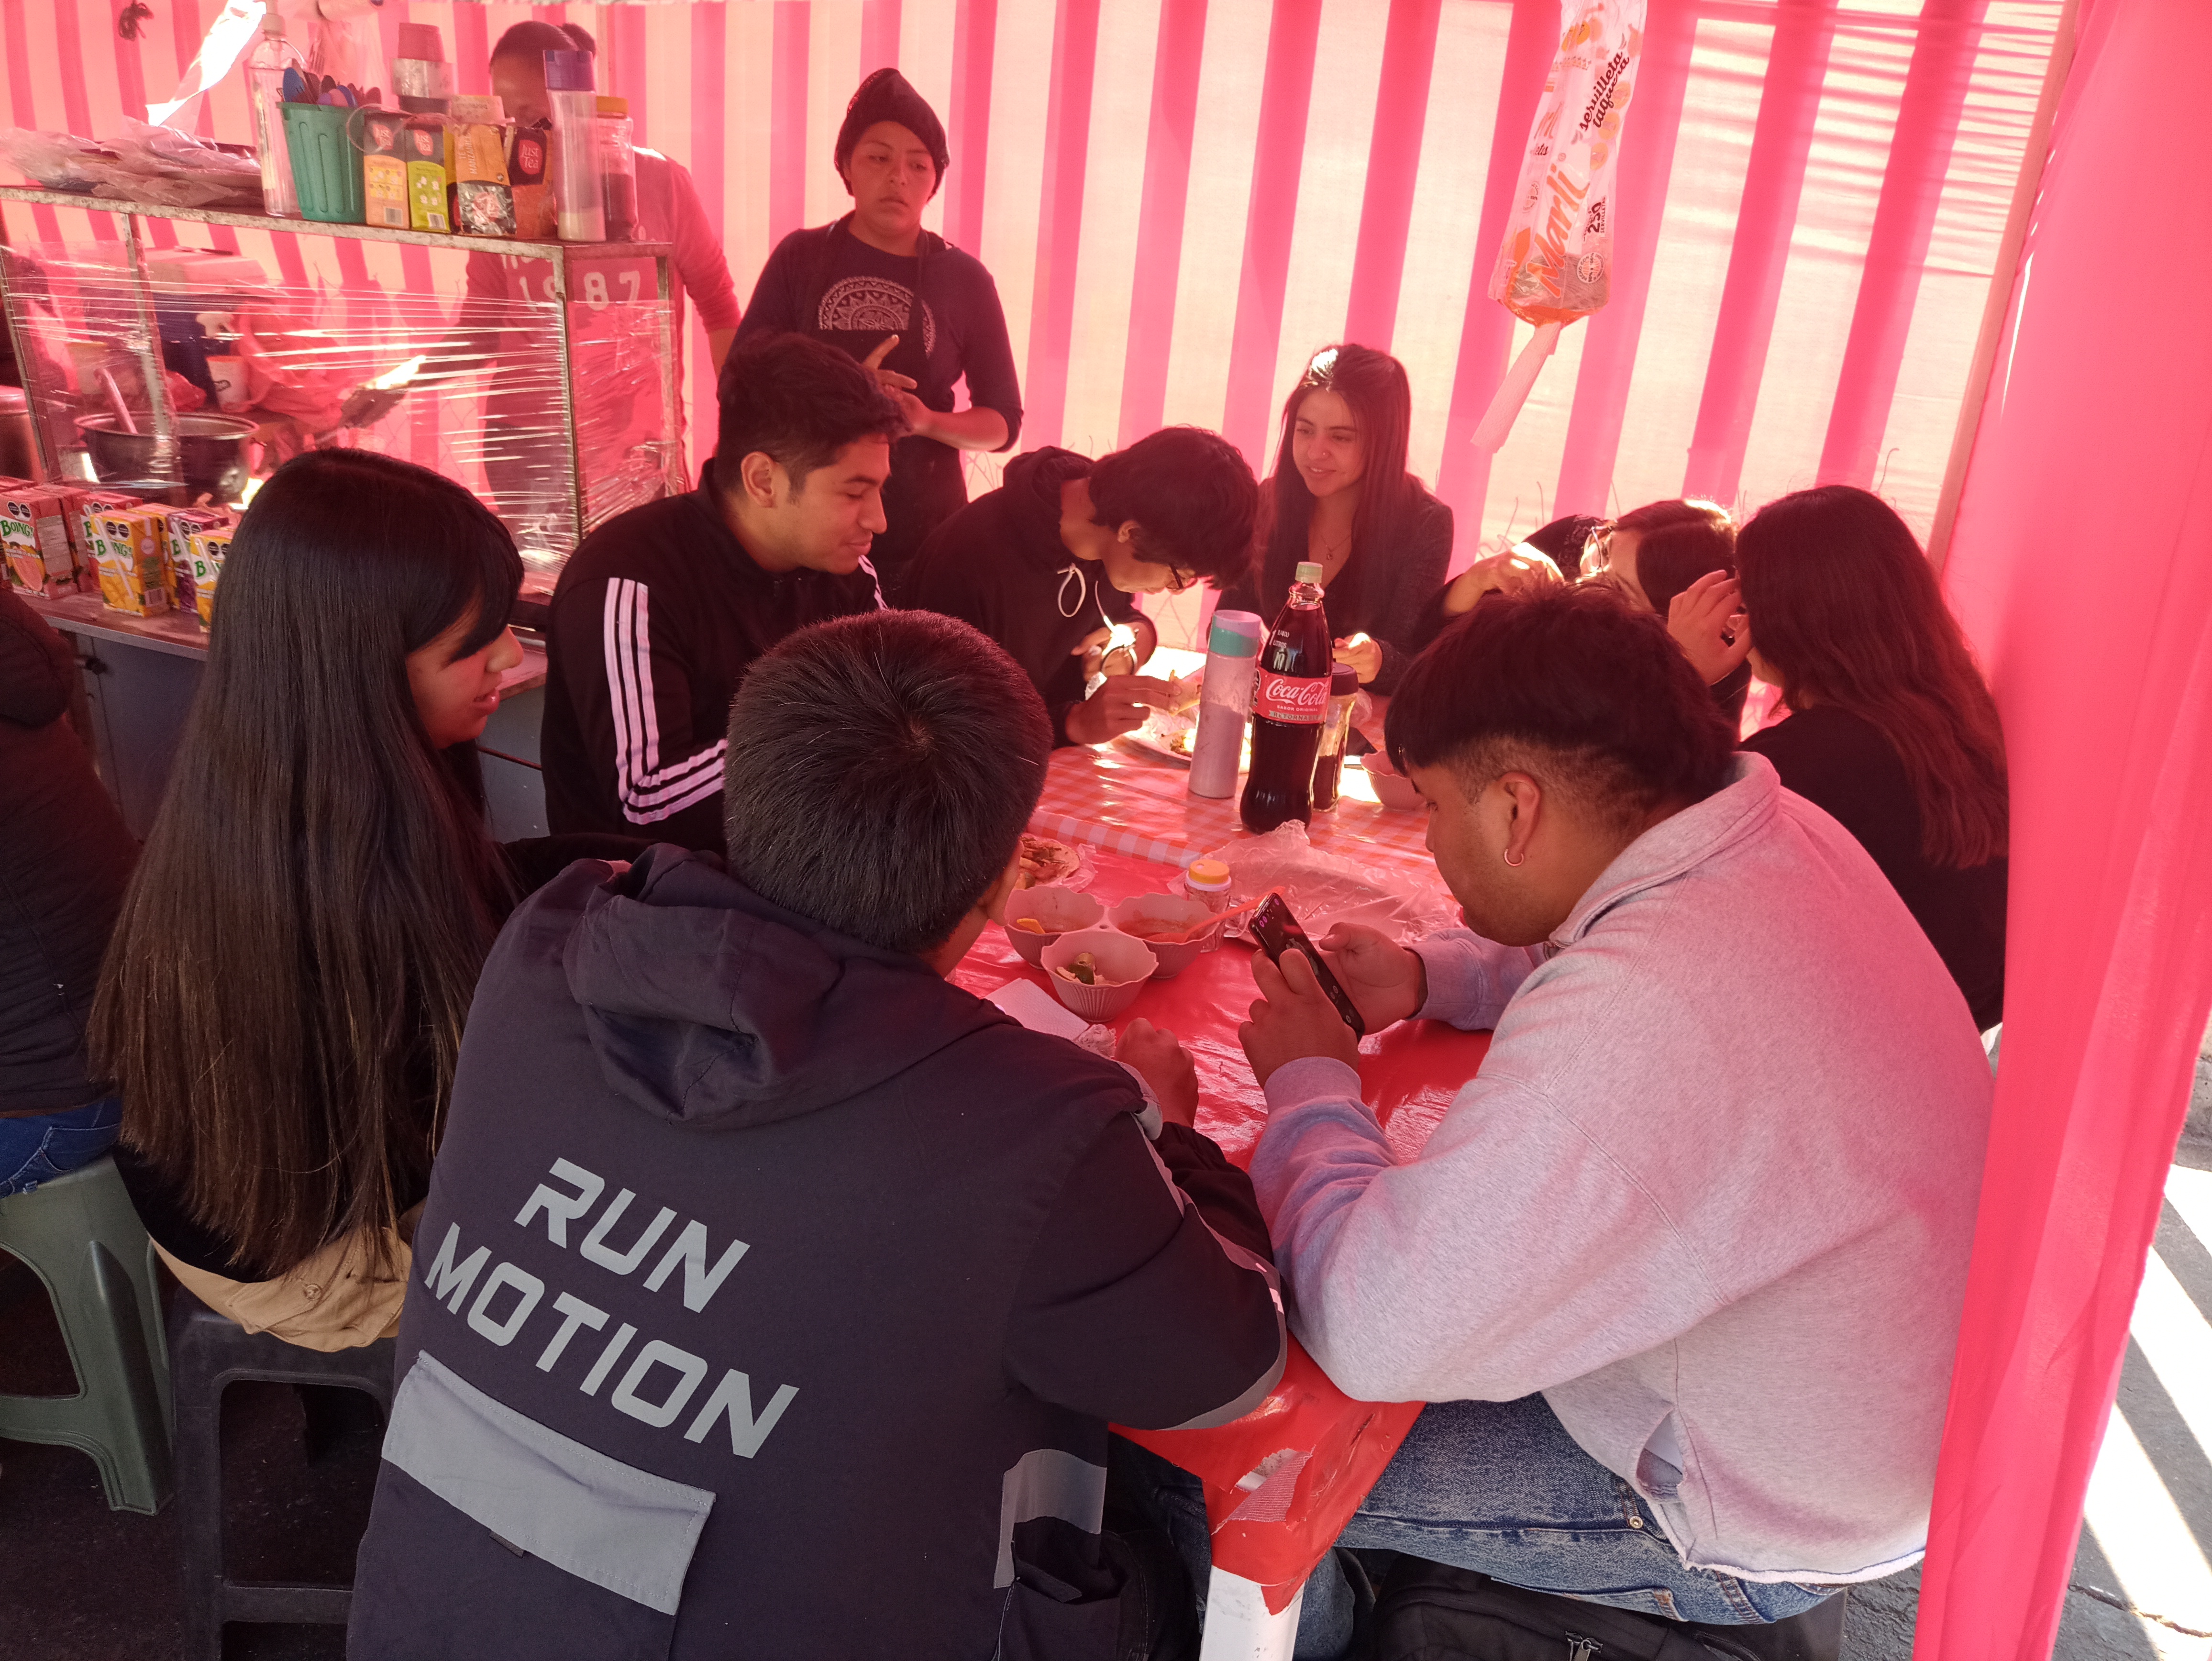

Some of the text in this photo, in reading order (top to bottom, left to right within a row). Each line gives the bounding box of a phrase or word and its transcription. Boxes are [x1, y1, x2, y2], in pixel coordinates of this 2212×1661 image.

[1580, 51, 1622, 131] servilleta
[1593, 56, 1629, 128] taquera
[519, 144, 539, 159] Just
[521, 156, 539, 169] Tea
[1526, 163, 1590, 299] Marli
[1587, 201, 1602, 233] 250
[0, 520, 34, 537] BOING!
[95, 539, 133, 559] BNG!
[1265, 678, 1327, 706] Coca-Cola
[514, 1157, 751, 1314] RUN
[424, 1221, 800, 1460] MOTION
